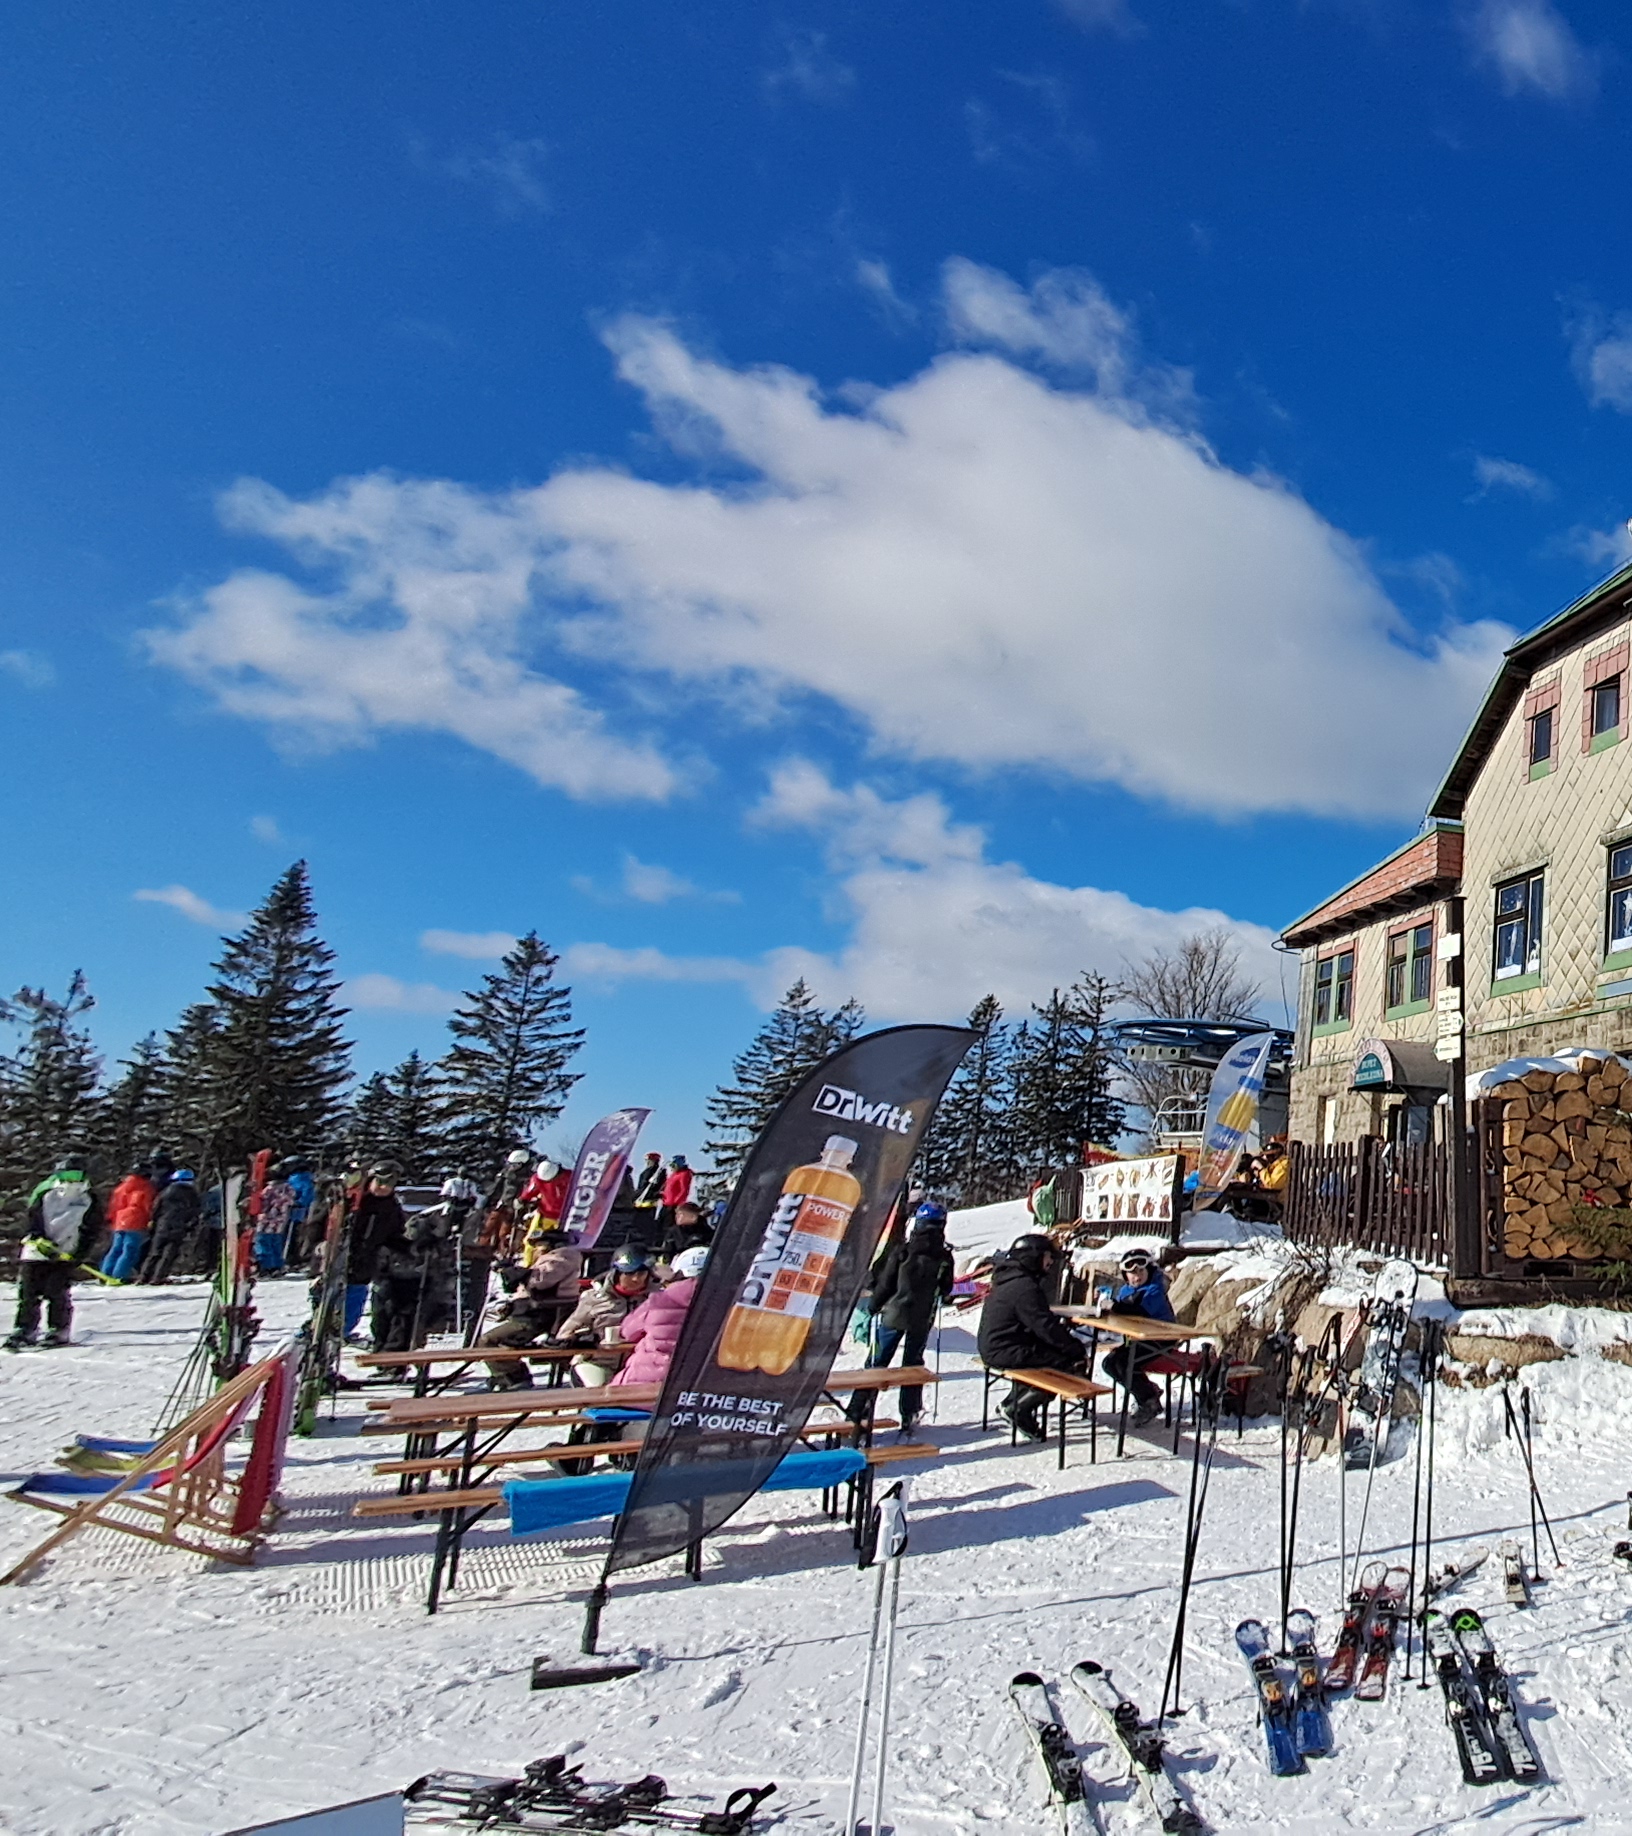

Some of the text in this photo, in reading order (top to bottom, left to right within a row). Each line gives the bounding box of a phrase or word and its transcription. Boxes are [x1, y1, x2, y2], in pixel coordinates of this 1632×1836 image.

[814, 1086, 914, 1135] DrWitt
[563, 1151, 611, 1232] TIGER
[806, 1202, 846, 1222] POWER
[676, 1391, 783, 1416] BE THE BEST
[670, 1412, 788, 1436] OF YOURSELF
